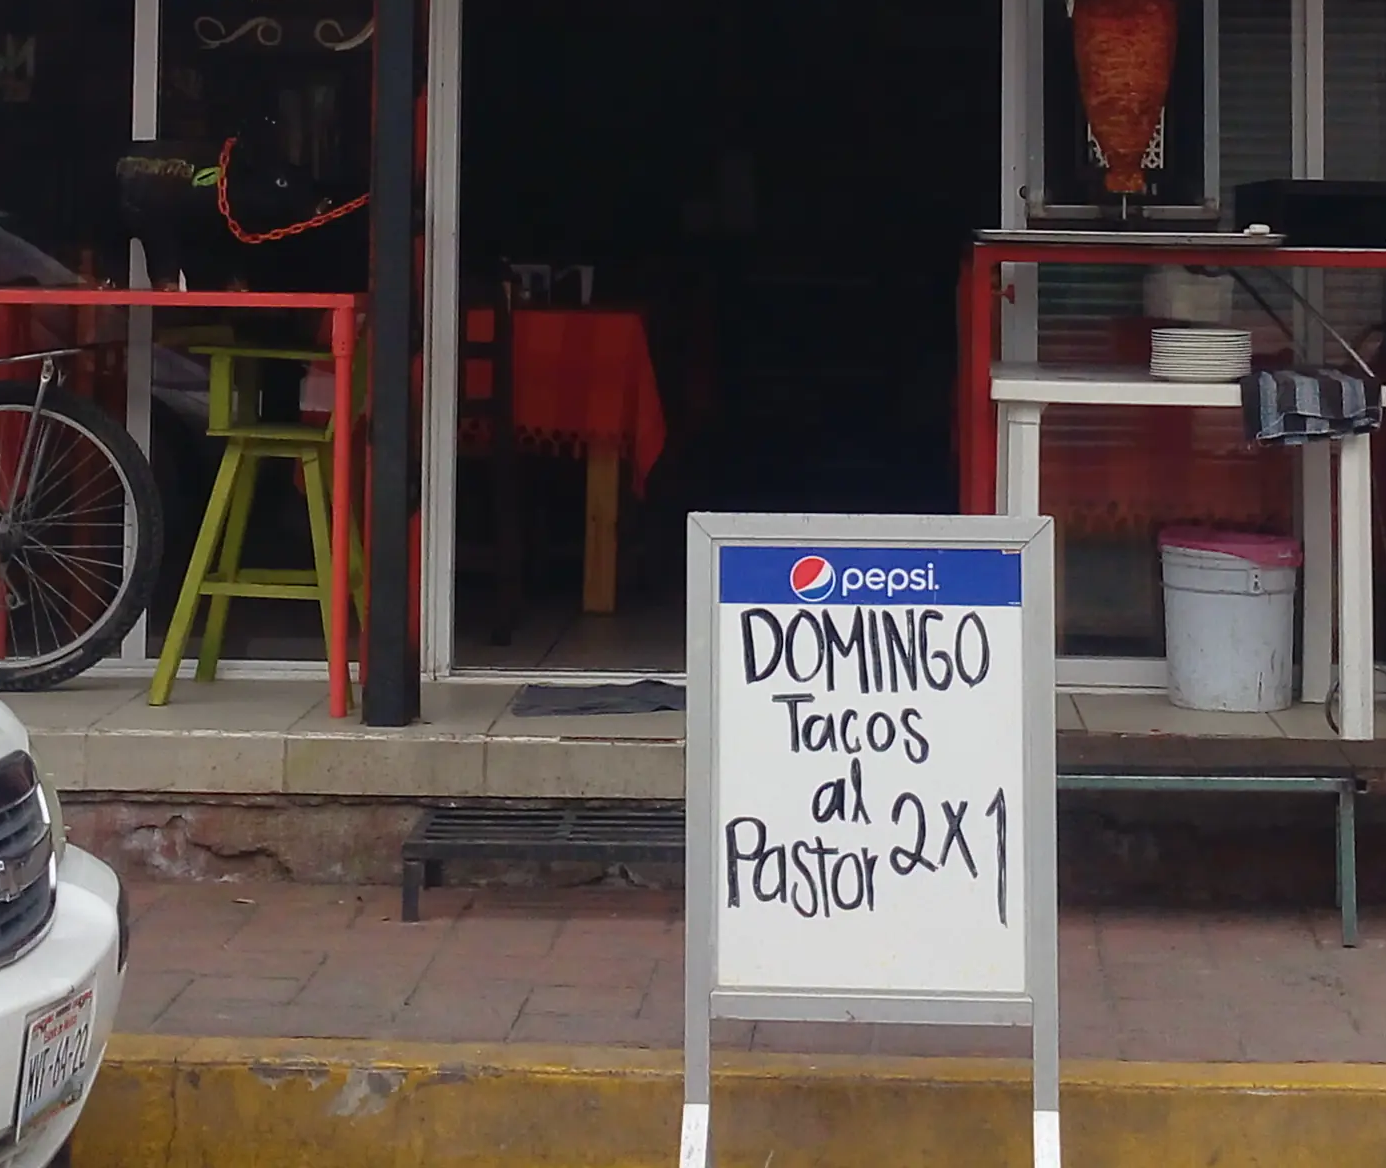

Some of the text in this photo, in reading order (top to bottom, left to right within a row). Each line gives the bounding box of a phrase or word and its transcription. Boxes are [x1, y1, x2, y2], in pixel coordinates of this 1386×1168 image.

[740, 606, 990, 694] DOMINGO
[771, 693, 929, 764] Tacos
[811, 757, 871, 825] al
[725, 816, 879, 918] Pastor
